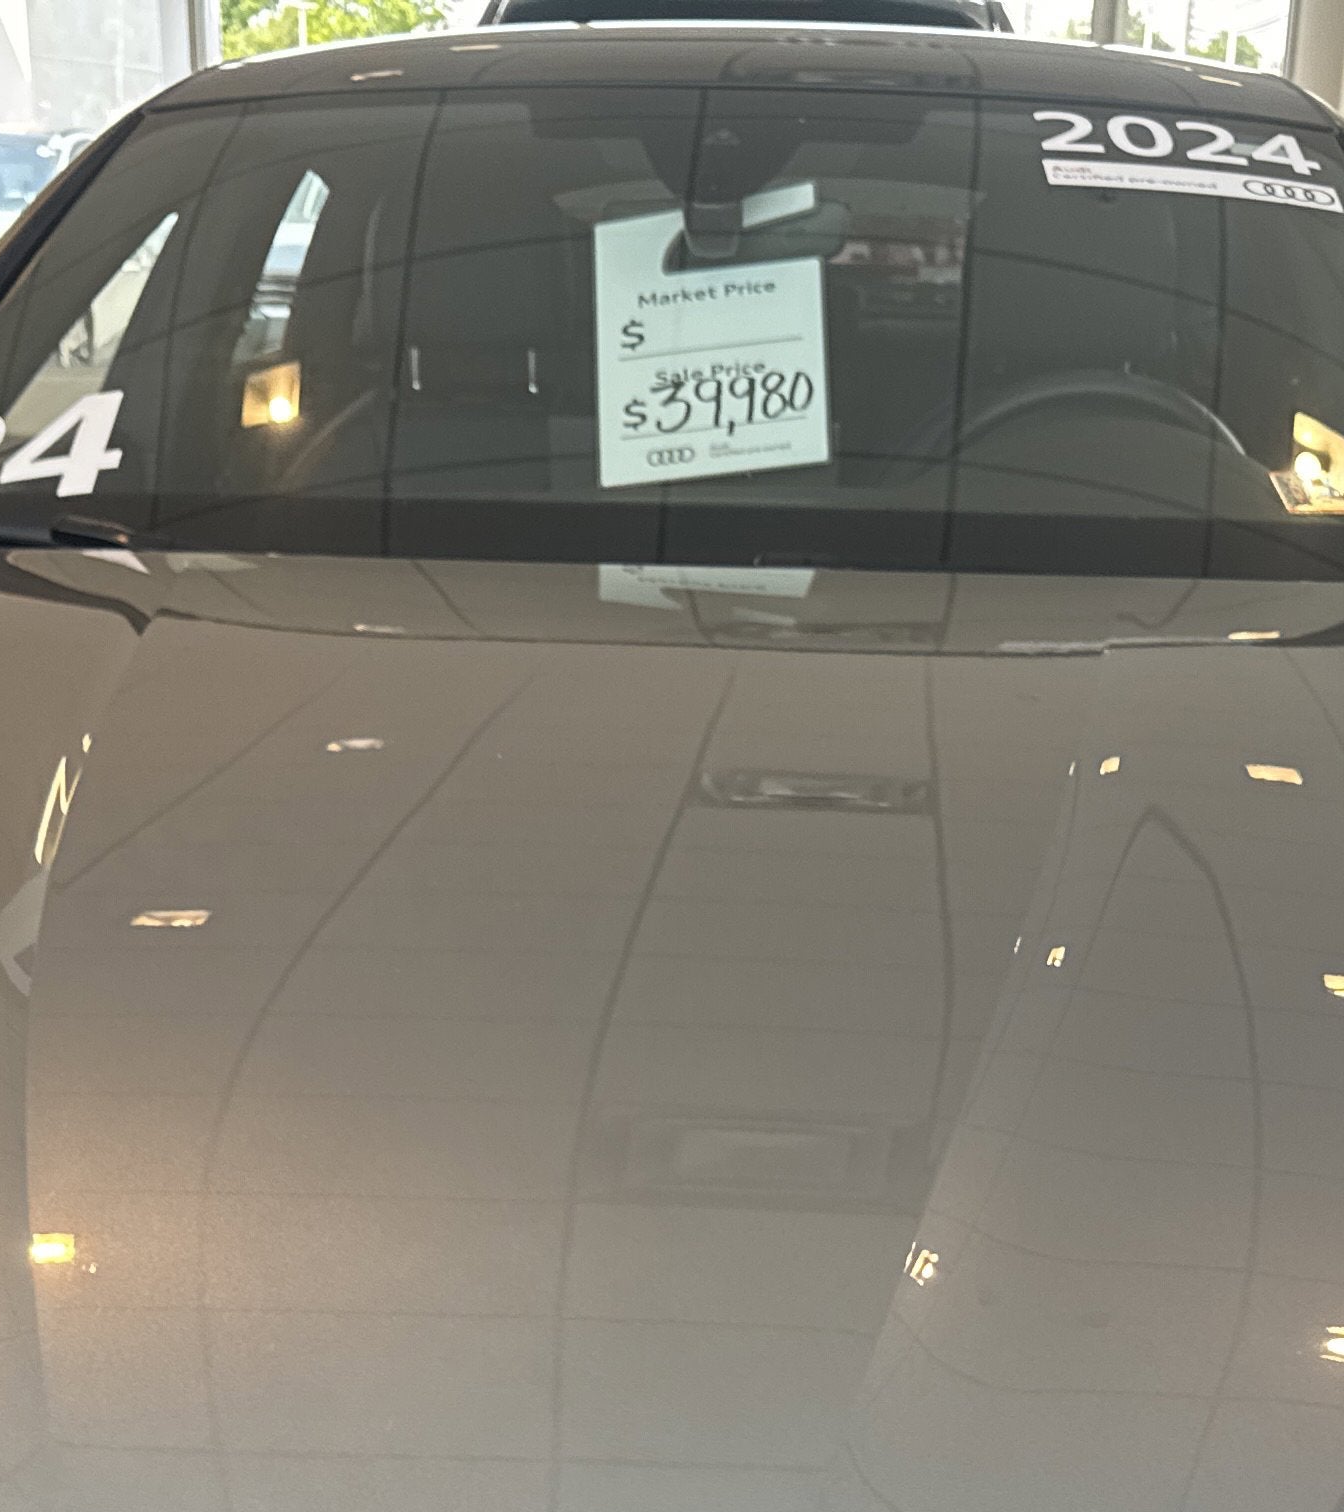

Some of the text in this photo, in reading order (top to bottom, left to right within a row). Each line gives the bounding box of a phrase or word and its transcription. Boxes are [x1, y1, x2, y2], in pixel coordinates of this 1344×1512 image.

[1033, 111, 1322, 176] 2024
[637, 280, 777, 308] Market Price
[620, 319, 646, 350] $
[655, 361, 766, 389] Sale Price
